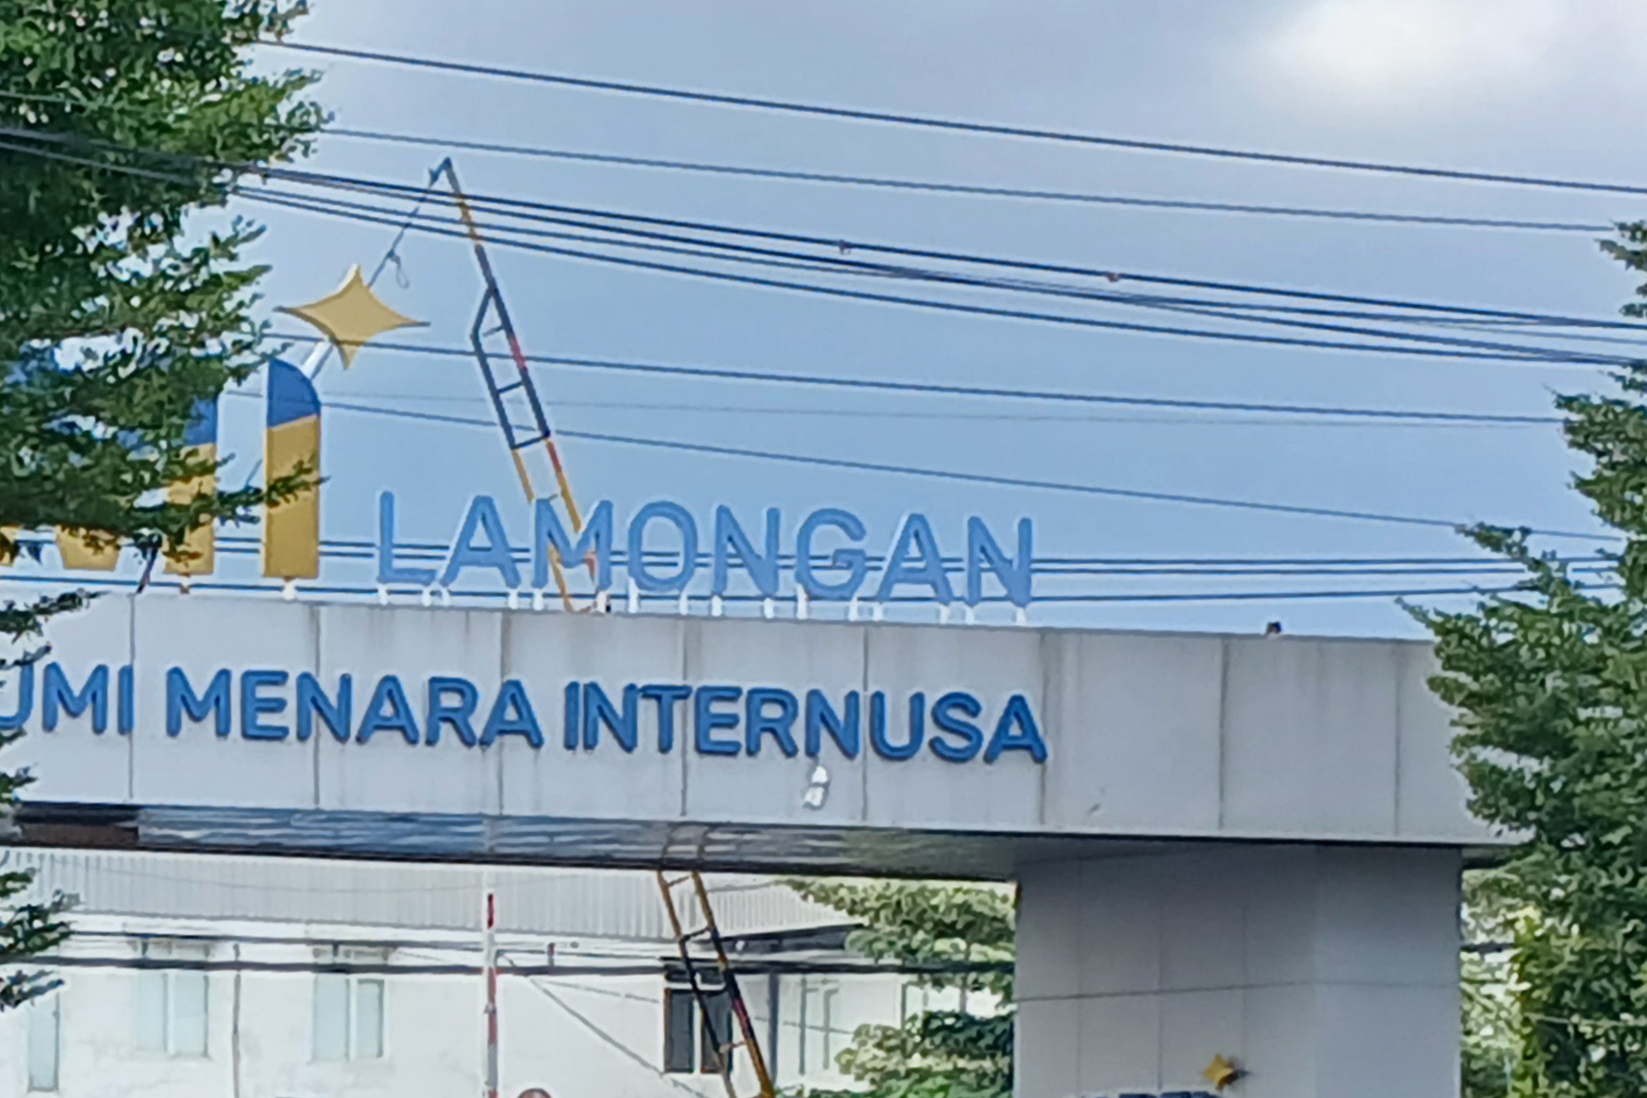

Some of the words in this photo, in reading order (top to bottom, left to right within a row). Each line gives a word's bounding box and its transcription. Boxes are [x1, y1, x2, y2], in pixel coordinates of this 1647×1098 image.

[377, 490, 1034, 606] LAMONGAN
[165, 666, 544, 748] MENARA
[564, 680, 1048, 764] INTERNUSA
